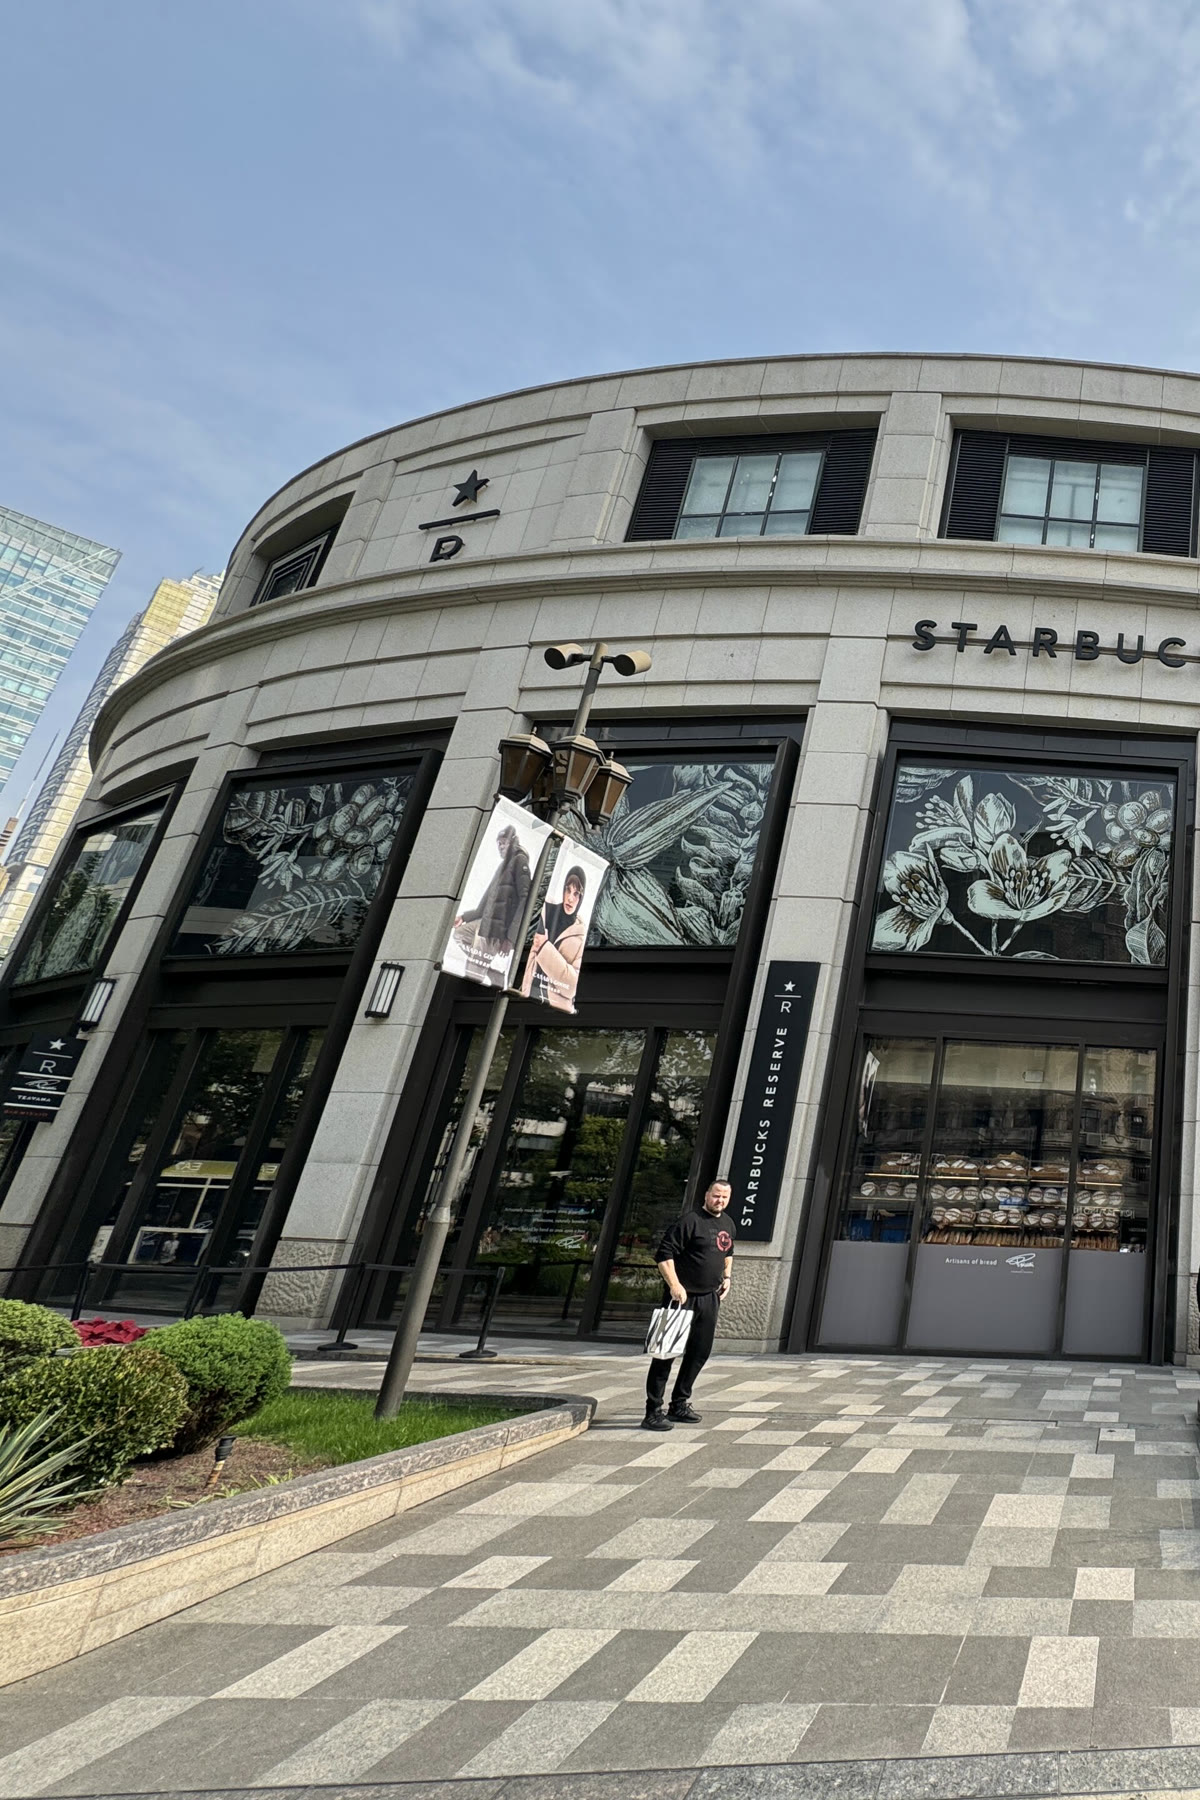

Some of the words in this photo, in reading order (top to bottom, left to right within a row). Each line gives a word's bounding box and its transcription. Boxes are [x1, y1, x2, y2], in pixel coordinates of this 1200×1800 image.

[779, 1001, 792, 1014] R
[39, 1060, 57, 1073] R
[740, 1119, 771, 1226] STARBUCKS
[762, 1027, 788, 1107] RESERVE
[945, 1257, 970, 1265] Artisans
